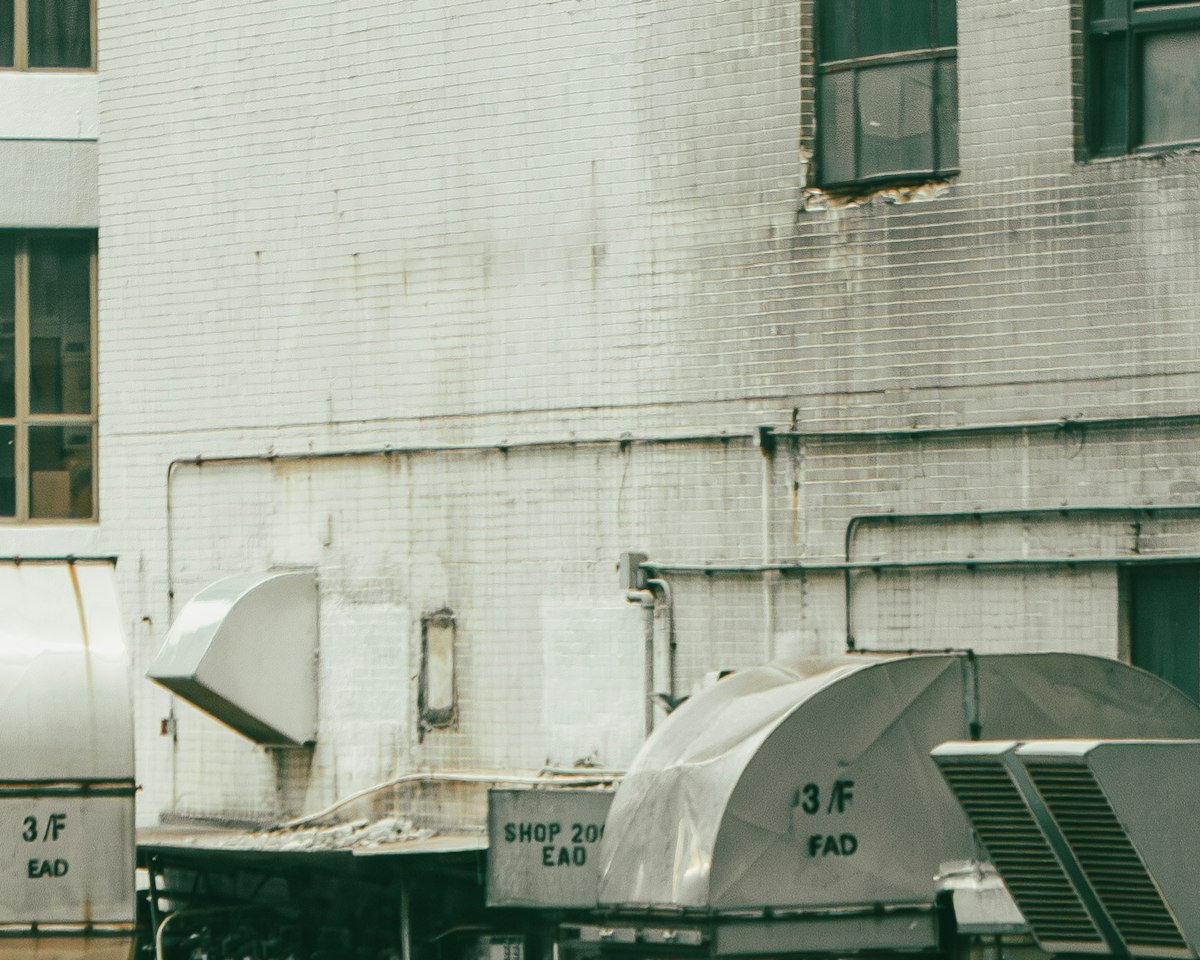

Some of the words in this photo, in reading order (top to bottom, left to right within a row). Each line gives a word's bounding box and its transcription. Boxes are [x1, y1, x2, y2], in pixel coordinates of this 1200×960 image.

[802, 780, 854, 815] 3/F
[22, 813, 66, 842] 3/F
[504, 823, 560, 842] SHOP
[571, 823, 605, 843] 20
[542, 846, 586, 866] EAD
[808, 833, 858, 857] FAD
[28, 858, 69, 878] EAD
